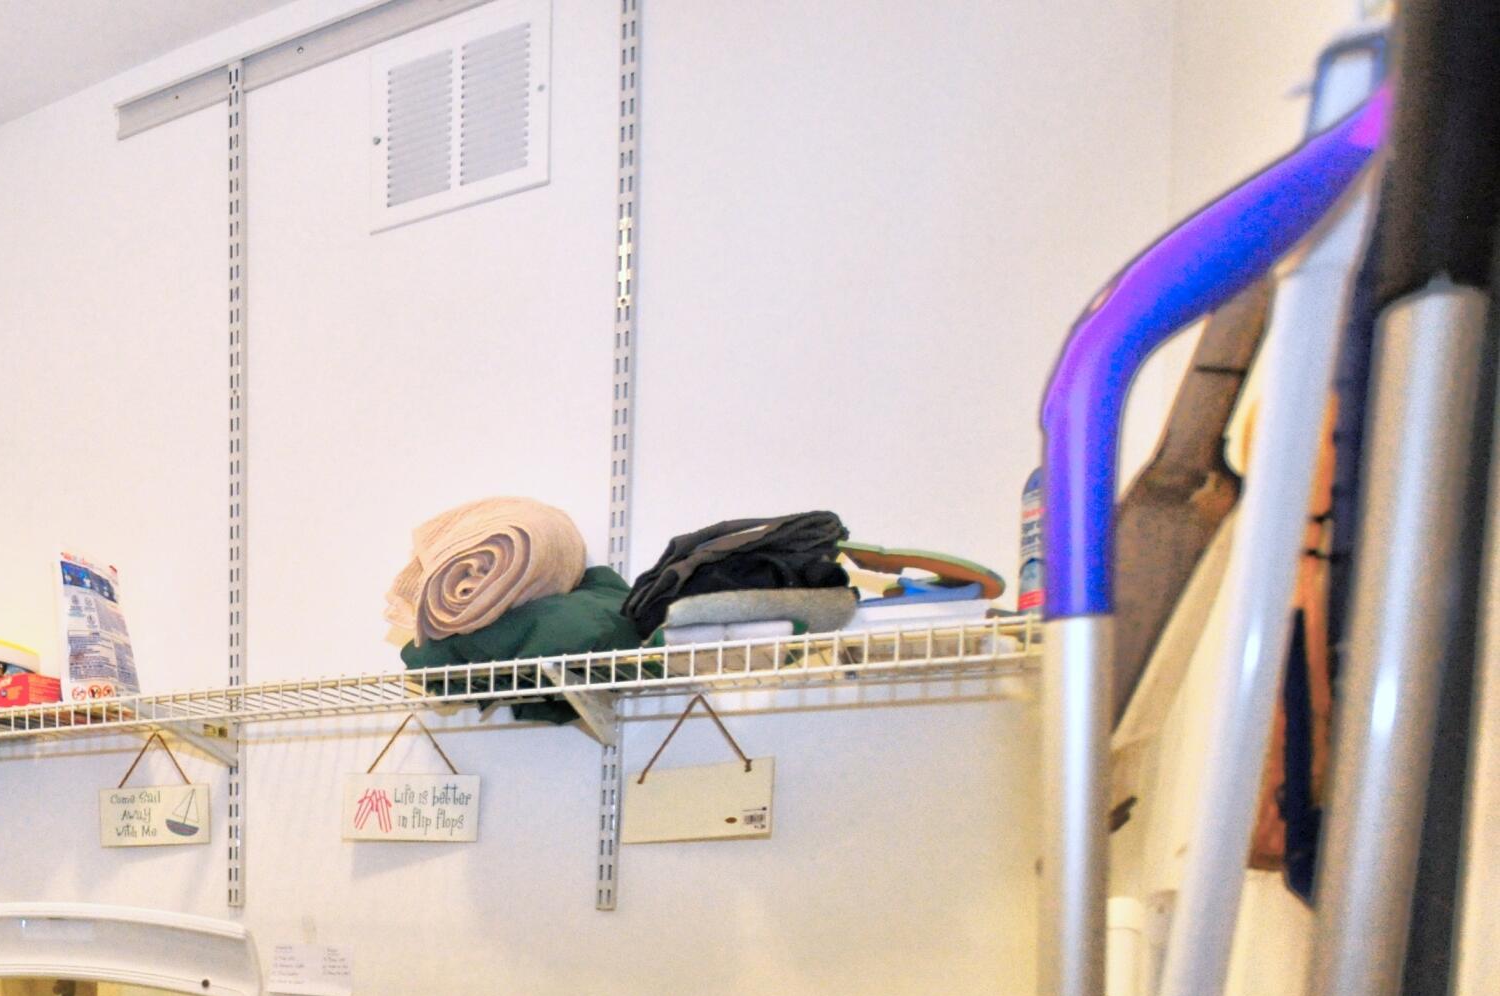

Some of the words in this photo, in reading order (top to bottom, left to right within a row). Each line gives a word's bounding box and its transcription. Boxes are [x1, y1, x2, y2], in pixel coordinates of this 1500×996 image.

[394, 784, 415, 805] Life
[419, 790, 428, 805] is
[432, 783, 472, 807] better
[398, 815, 408, 829] in
[412, 807, 432, 835] flip
[436, 807, 464, 836] flops
